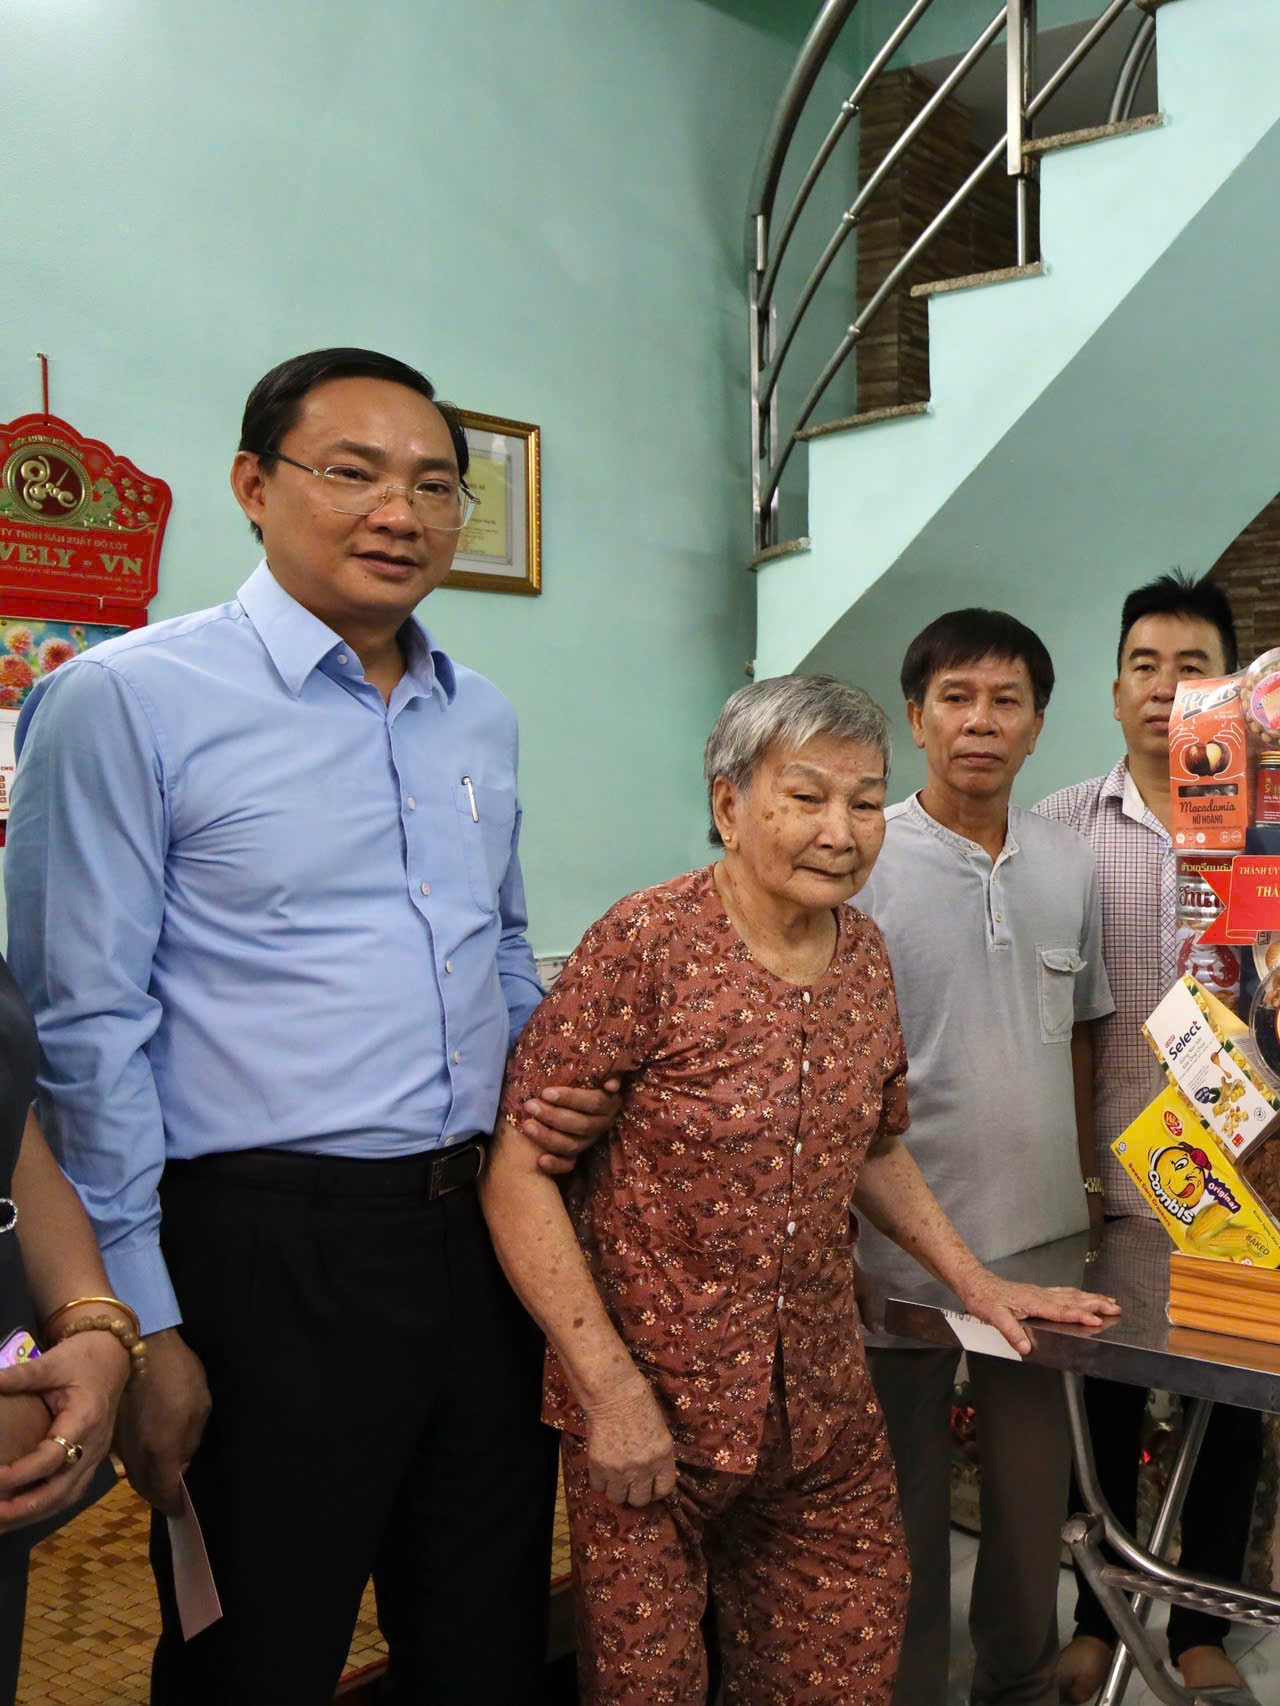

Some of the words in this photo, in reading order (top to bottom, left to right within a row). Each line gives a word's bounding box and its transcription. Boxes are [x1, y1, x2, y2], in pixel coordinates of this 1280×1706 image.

[101, 554, 143, 576] VN
[1179, 799, 1236, 813] Macadamia
[1202, 814, 1223, 824] HOÀNG
[1169, 1021, 1201, 1060] Select
[1128, 1163, 1142, 1183] Sweet
[1141, 1183, 1153, 1198] Corn
[1148, 1169, 1195, 1225] cornbis
[1208, 1182, 1238, 1211] Original
[1245, 1233, 1270, 1256] BAKED
